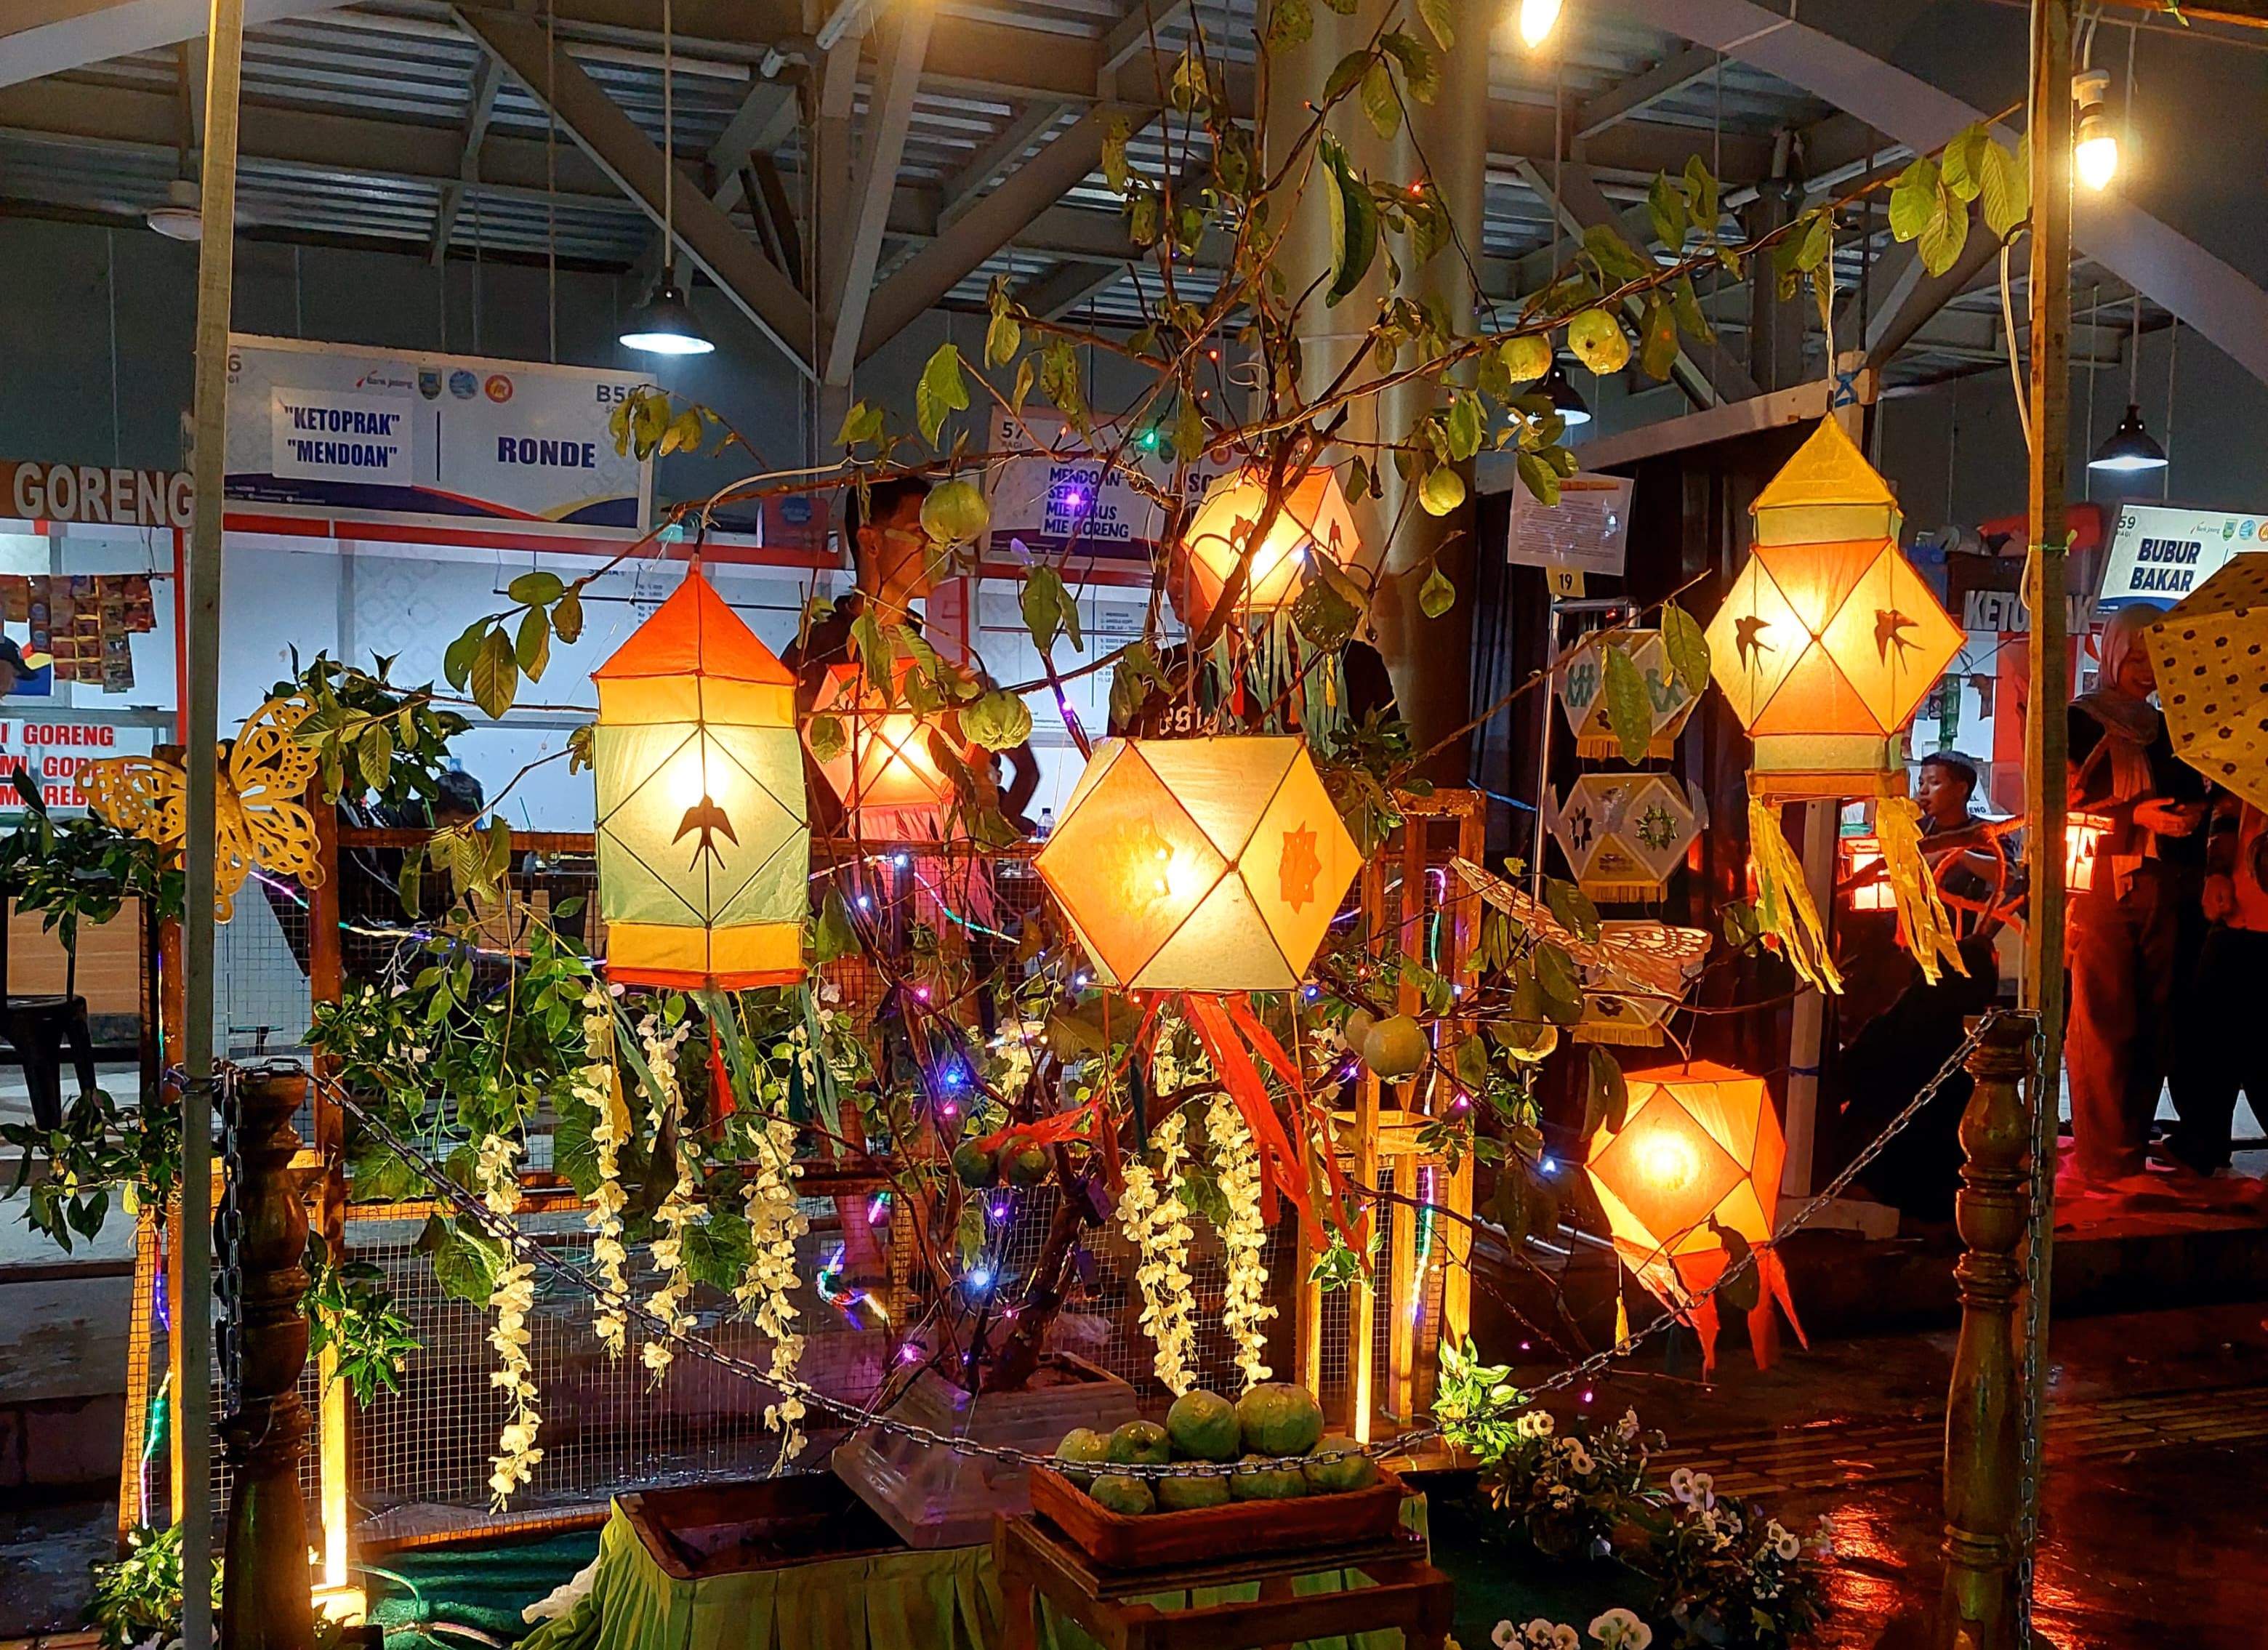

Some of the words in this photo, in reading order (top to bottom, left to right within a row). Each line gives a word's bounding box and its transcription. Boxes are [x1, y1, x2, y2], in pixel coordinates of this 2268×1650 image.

[284, 406, 400, 436] "KETOPRAK"
[288, 440, 398, 468] "MENDOAN"
[498, 436, 596, 468] RONDE
[14, 462, 194, 528] GORENG
[1046, 501, 1071, 517] MIE
[1044, 518, 1069, 534] MIE
[2138, 538, 2202, 564] BUBUR
[1559, 573, 1573, 591] 19
[2129, 567, 2195, 592] BAKAR
[23, 725, 114, 746] GORENG
[44, 786, 87, 806] REB
